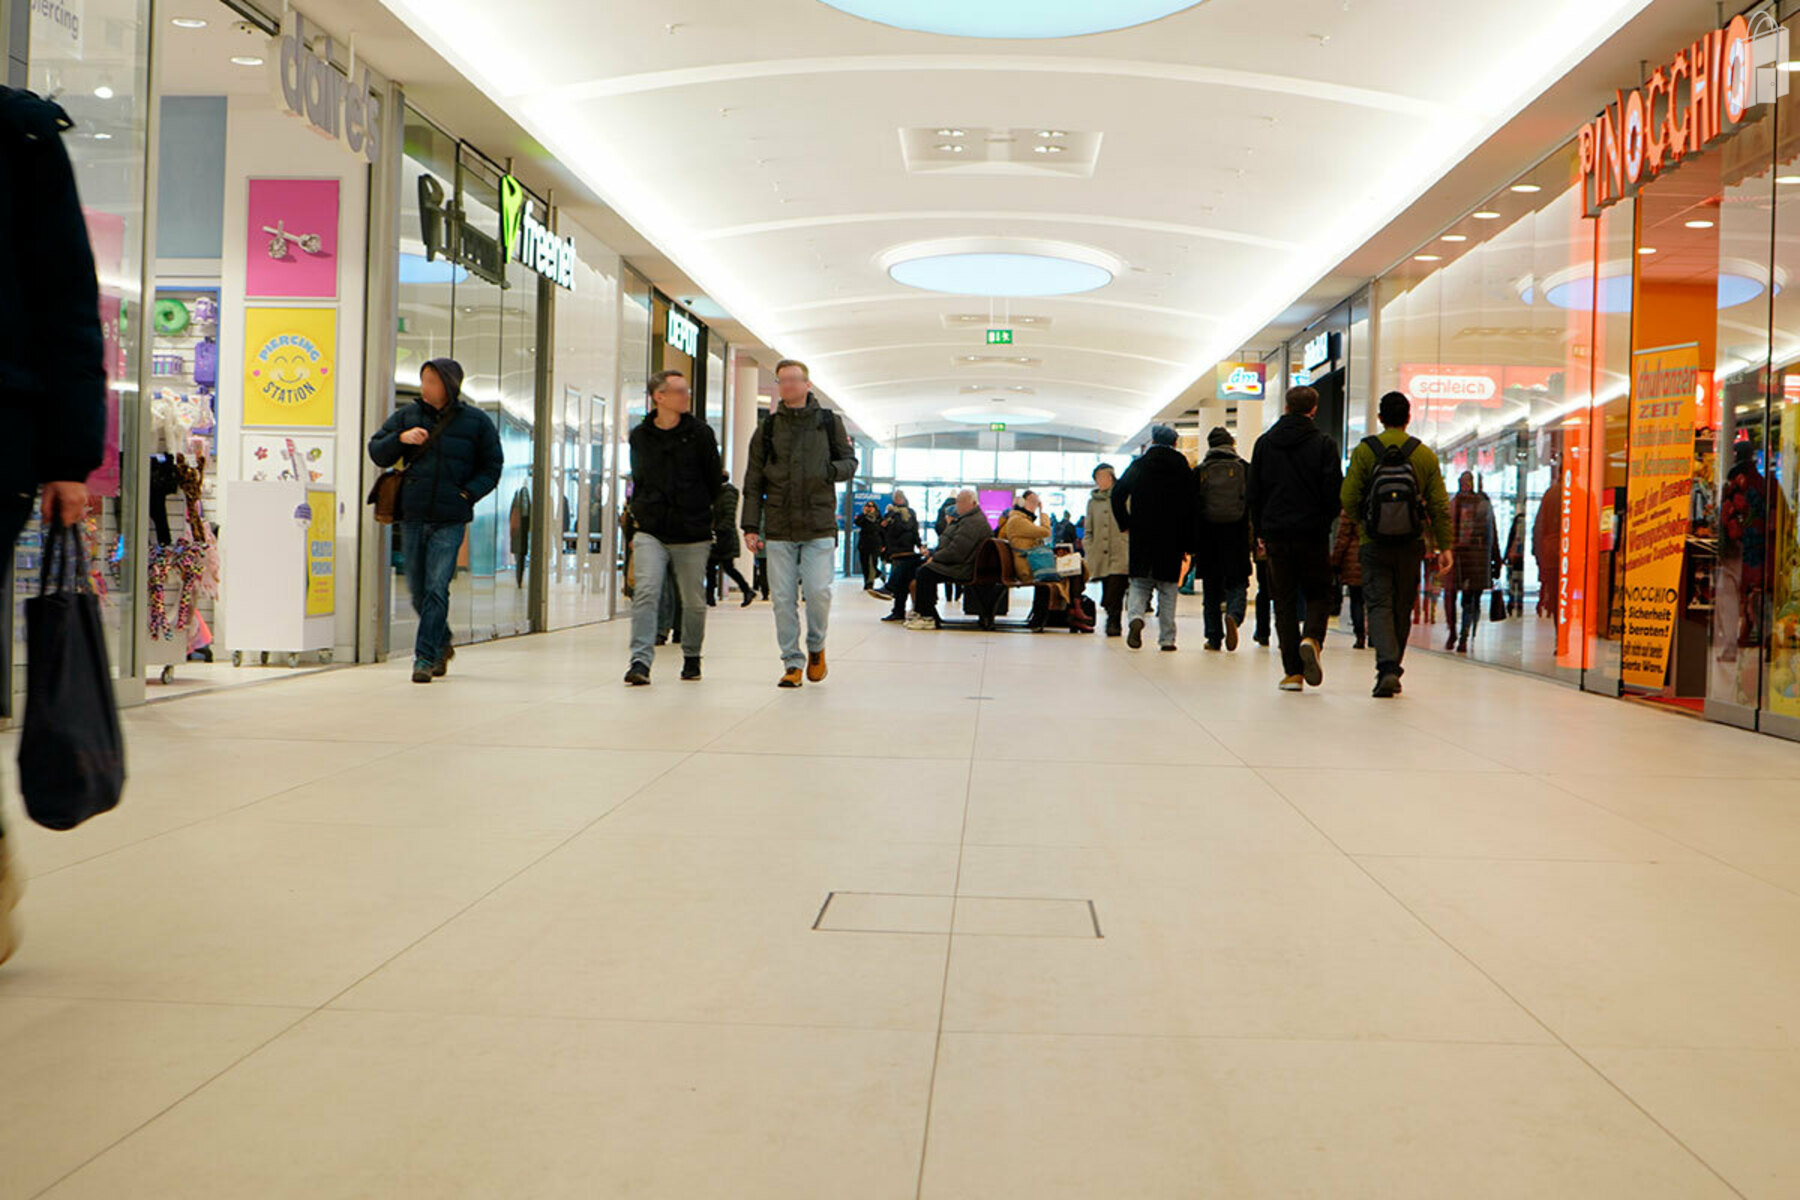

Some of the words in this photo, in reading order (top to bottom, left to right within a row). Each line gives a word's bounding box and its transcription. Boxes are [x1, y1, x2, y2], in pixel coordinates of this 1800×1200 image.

[1578, 15, 1754, 219] PINOCCHIO
[522, 200, 576, 291] freenet
[668, 309, 700, 358] DEPOT
[258, 335, 320, 361] PIERCING
[263, 381, 317, 403] STATION
[1639, 400, 1683, 419] ZEIT
[1555, 469, 1572, 625] PINOCCHIO
[1628, 606, 1671, 621] Sicherheit
[1628, 622, 1669, 637] beraten!
